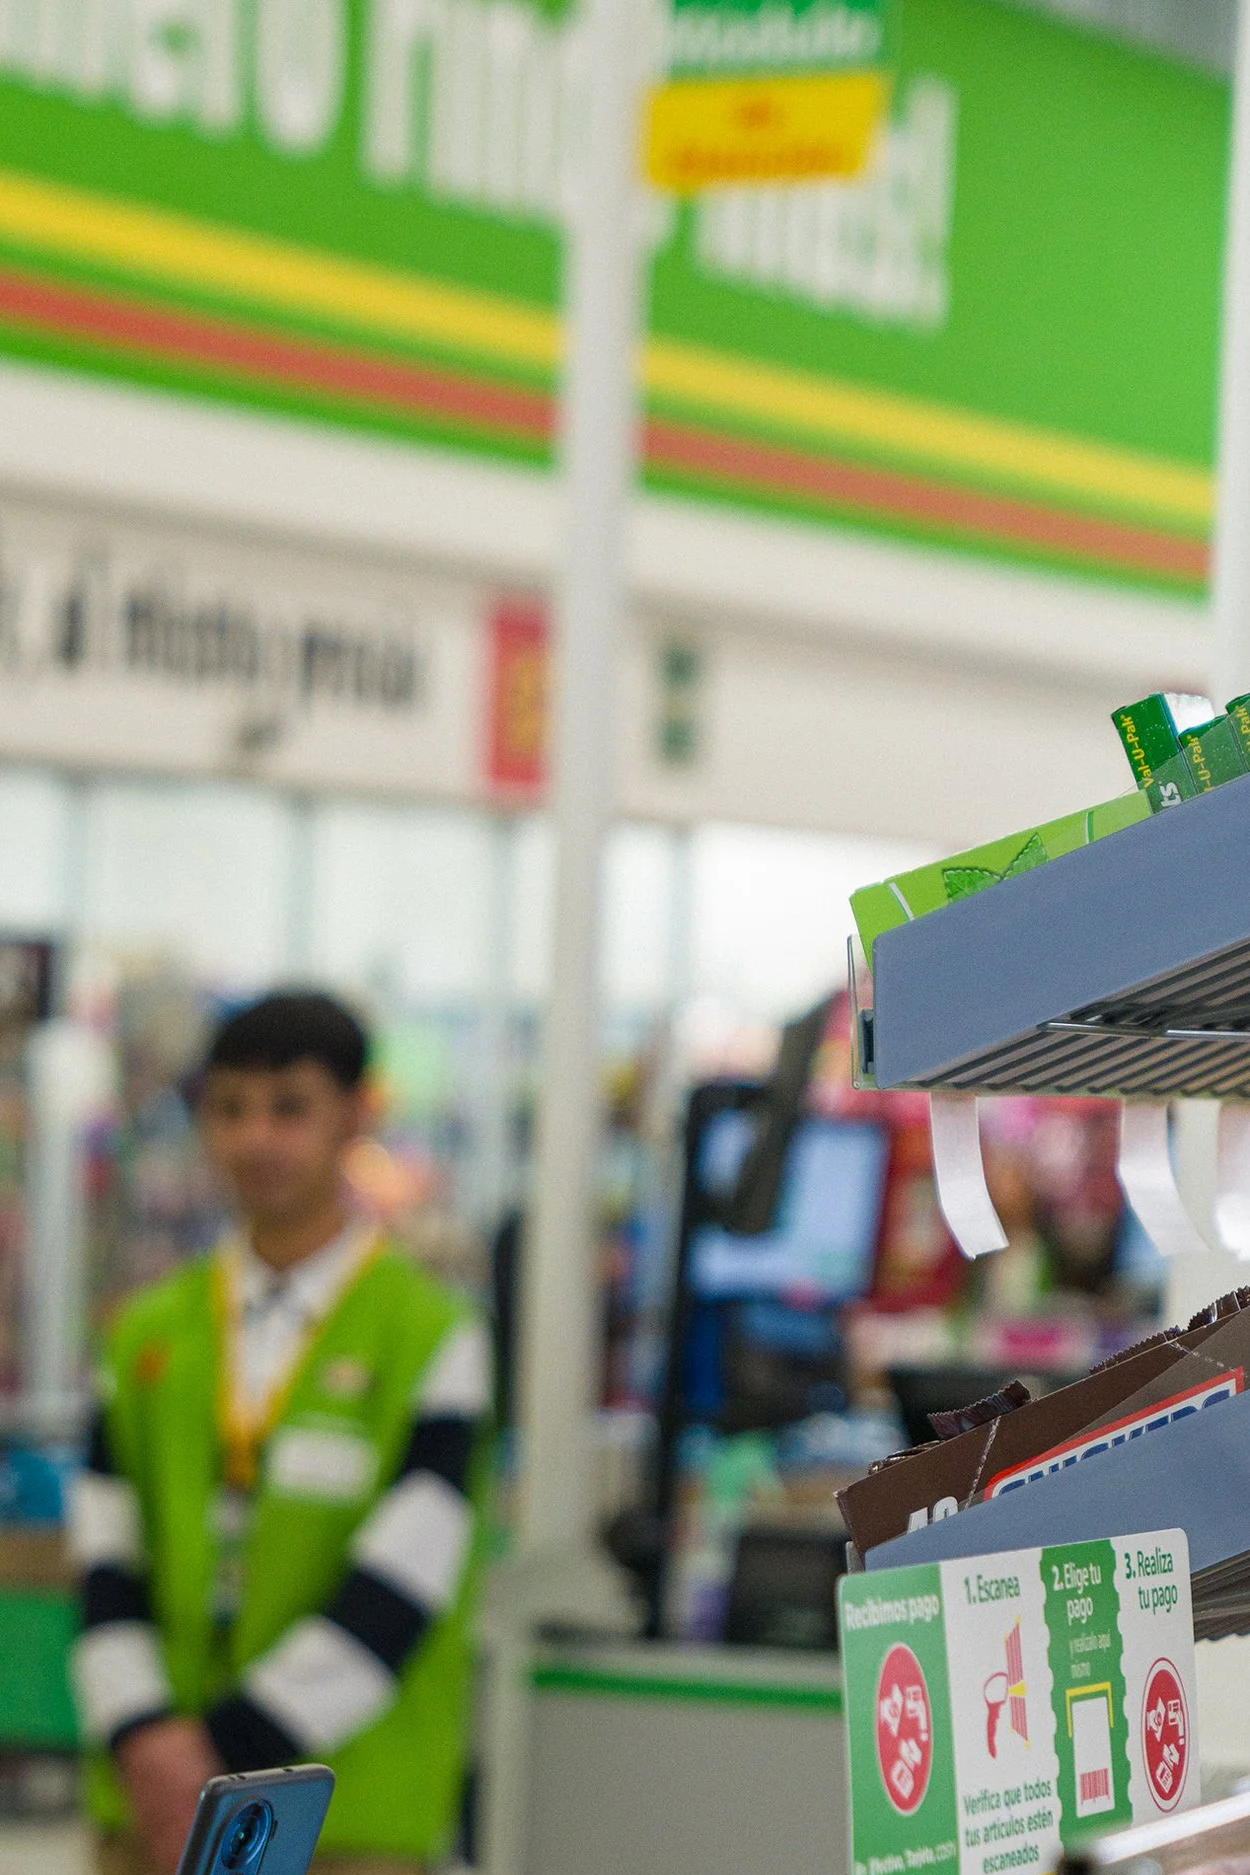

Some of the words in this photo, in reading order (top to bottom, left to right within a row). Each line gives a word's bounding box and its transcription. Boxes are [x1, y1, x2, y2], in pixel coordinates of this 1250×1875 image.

[1187, 735, 1216, 793] l-U-Pak
[1064, 1561, 1089, 1594] Elige
[1090, 1562, 1102, 1586] tu
[1125, 1551, 1136, 1579] 3.
[1137, 1547, 1174, 1578] Realiza
[977, 1573, 1021, 1604] Escanea
[1138, 1587, 1150, 1610] tu
[1151, 1584, 1178, 1615] pago
[1067, 1596, 1093, 1625] pago
[963, 1788, 1001, 1816] Verifica
[1003, 1786, 1021, 1810] que
[1023, 1777, 1052, 1802] todos
[965, 1826, 981, 1848] tus
[982, 1841, 1040, 1875] escaneados
